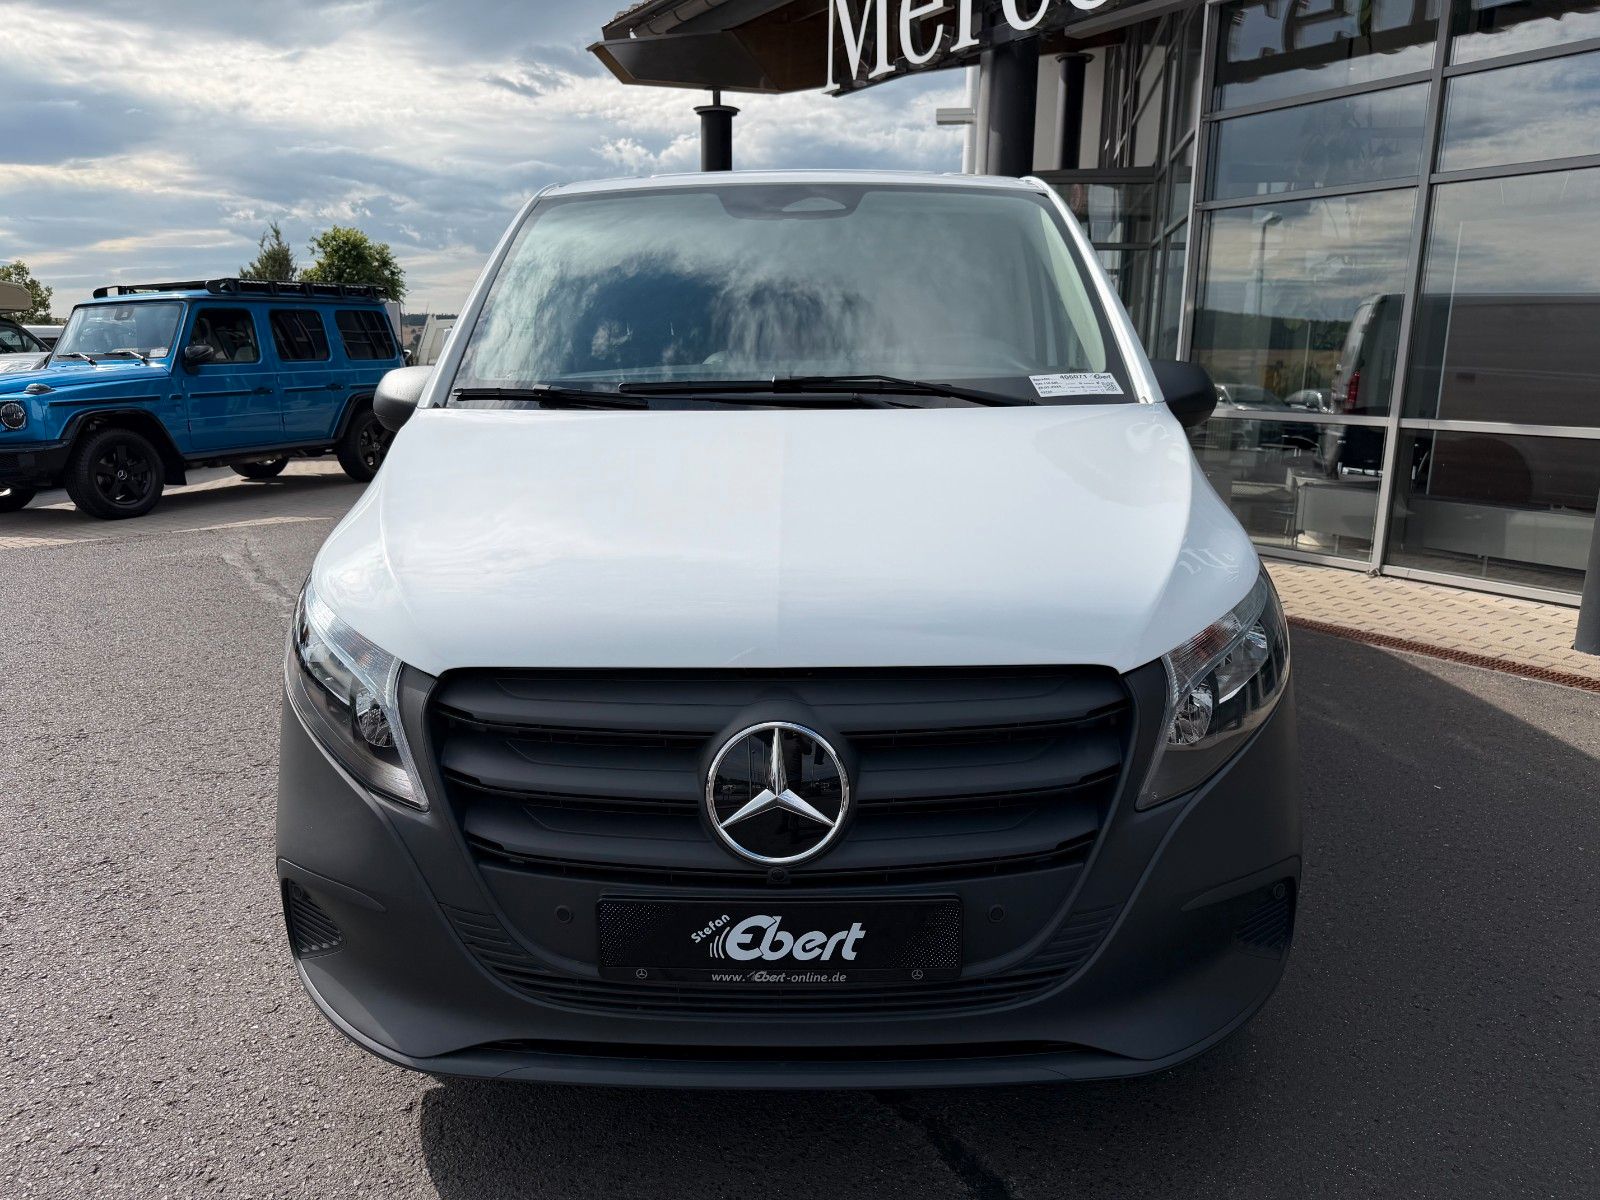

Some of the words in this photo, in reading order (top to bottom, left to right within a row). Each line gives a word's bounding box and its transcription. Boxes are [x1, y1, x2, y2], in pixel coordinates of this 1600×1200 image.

[825, 0, 1106, 90] Mer
[690, 914, 731, 944] Stefan
[725, 914, 867, 961] Ebert
